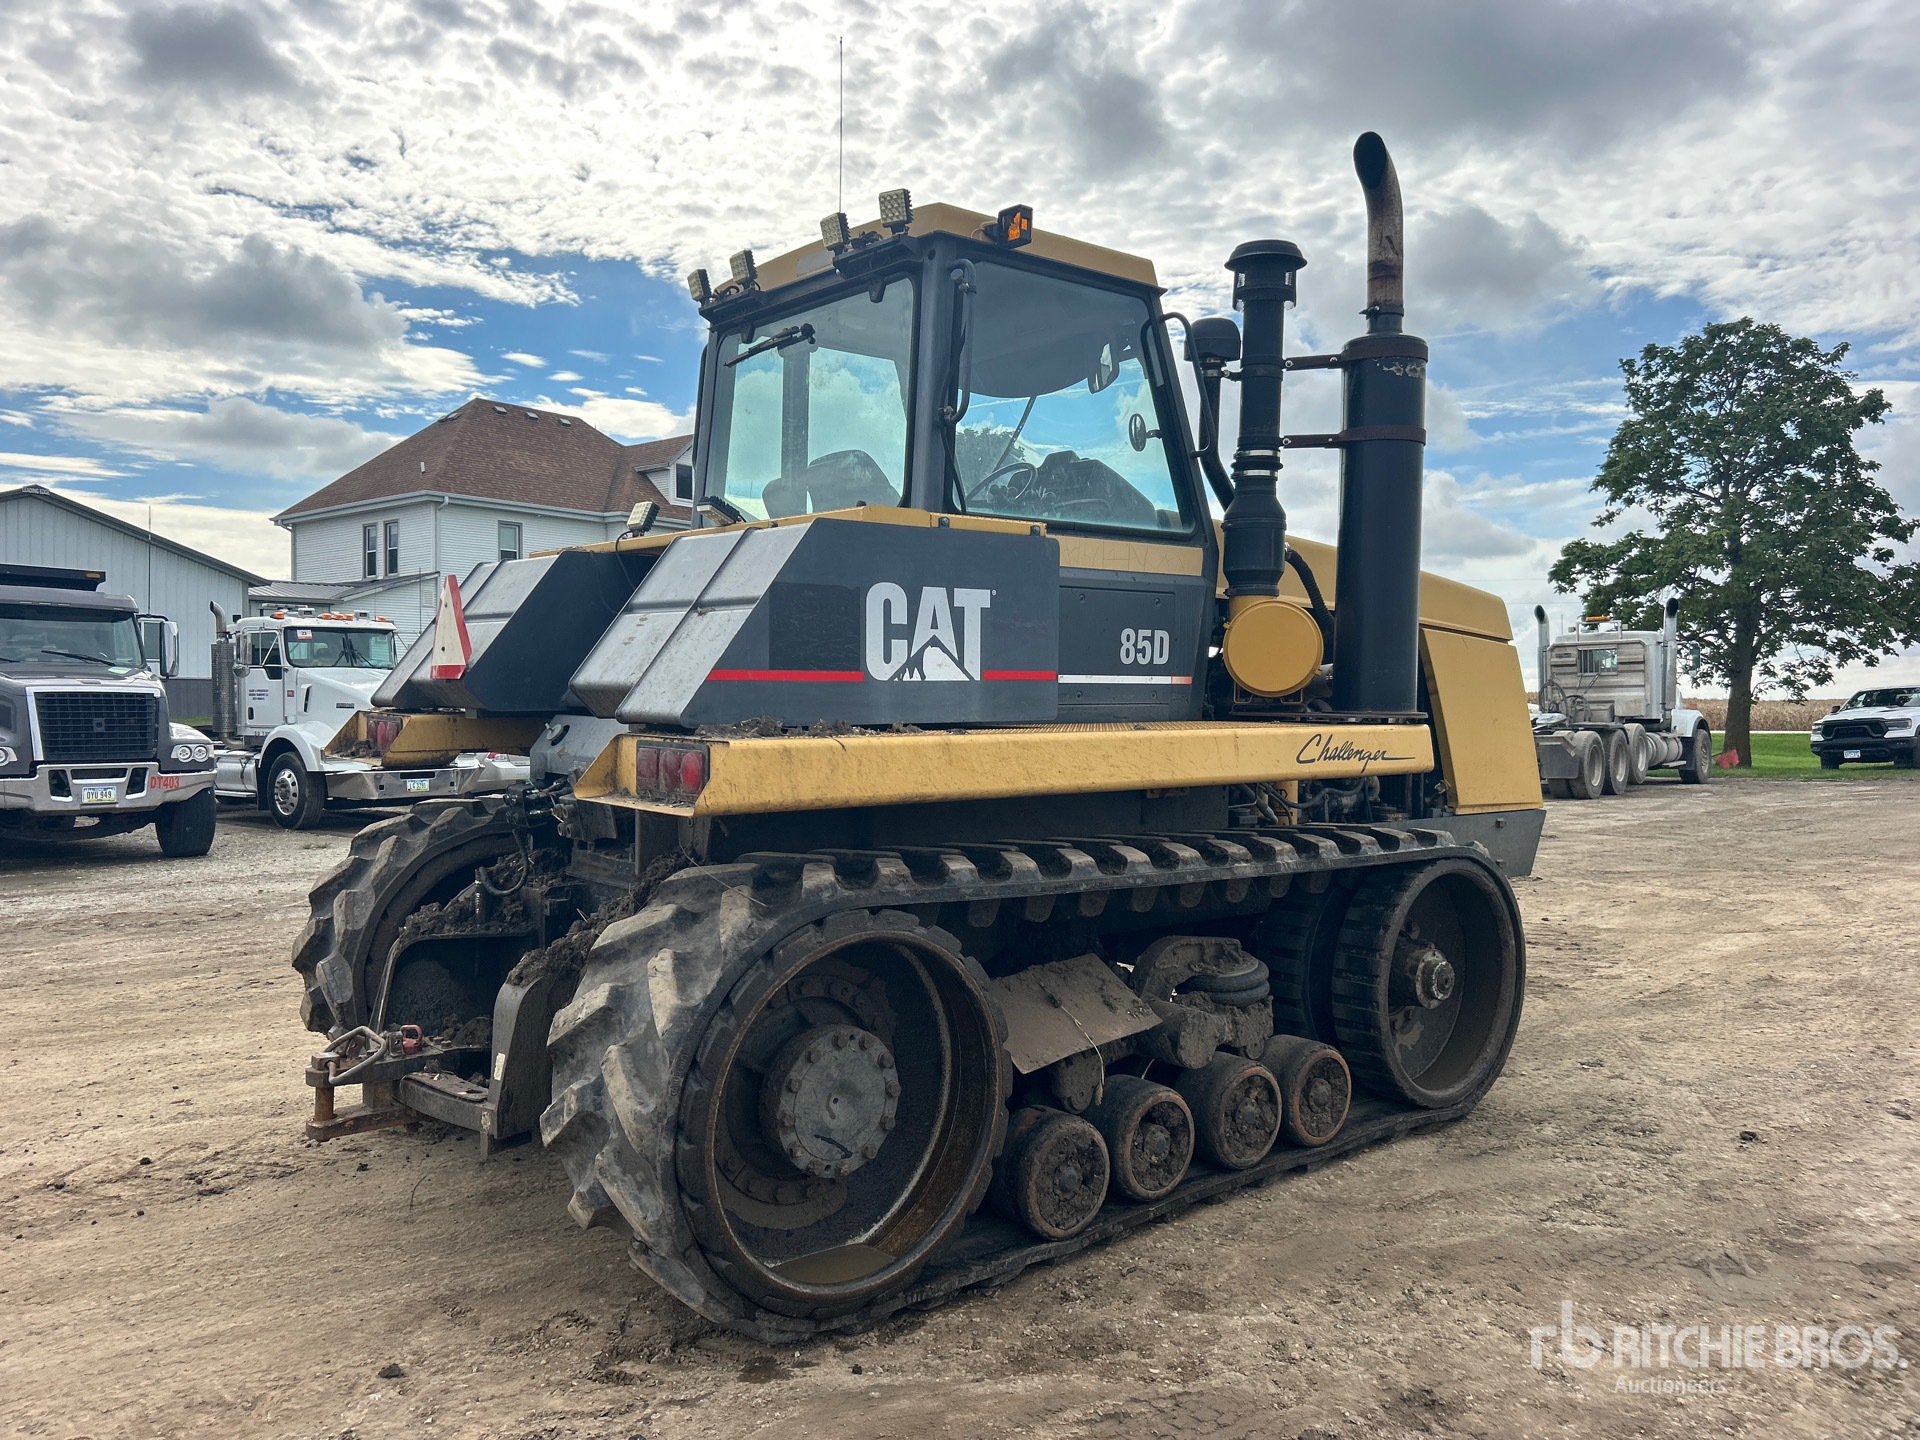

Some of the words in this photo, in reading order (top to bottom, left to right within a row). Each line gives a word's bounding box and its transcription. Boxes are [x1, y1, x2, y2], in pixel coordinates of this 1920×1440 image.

[866, 582, 991, 681] CAT
[1119, 628, 1170, 665] 85D
[1296, 734, 1415, 773] Challenger
[100, 790, 112, 799] 949
[150, 776, 180, 790] DT403
